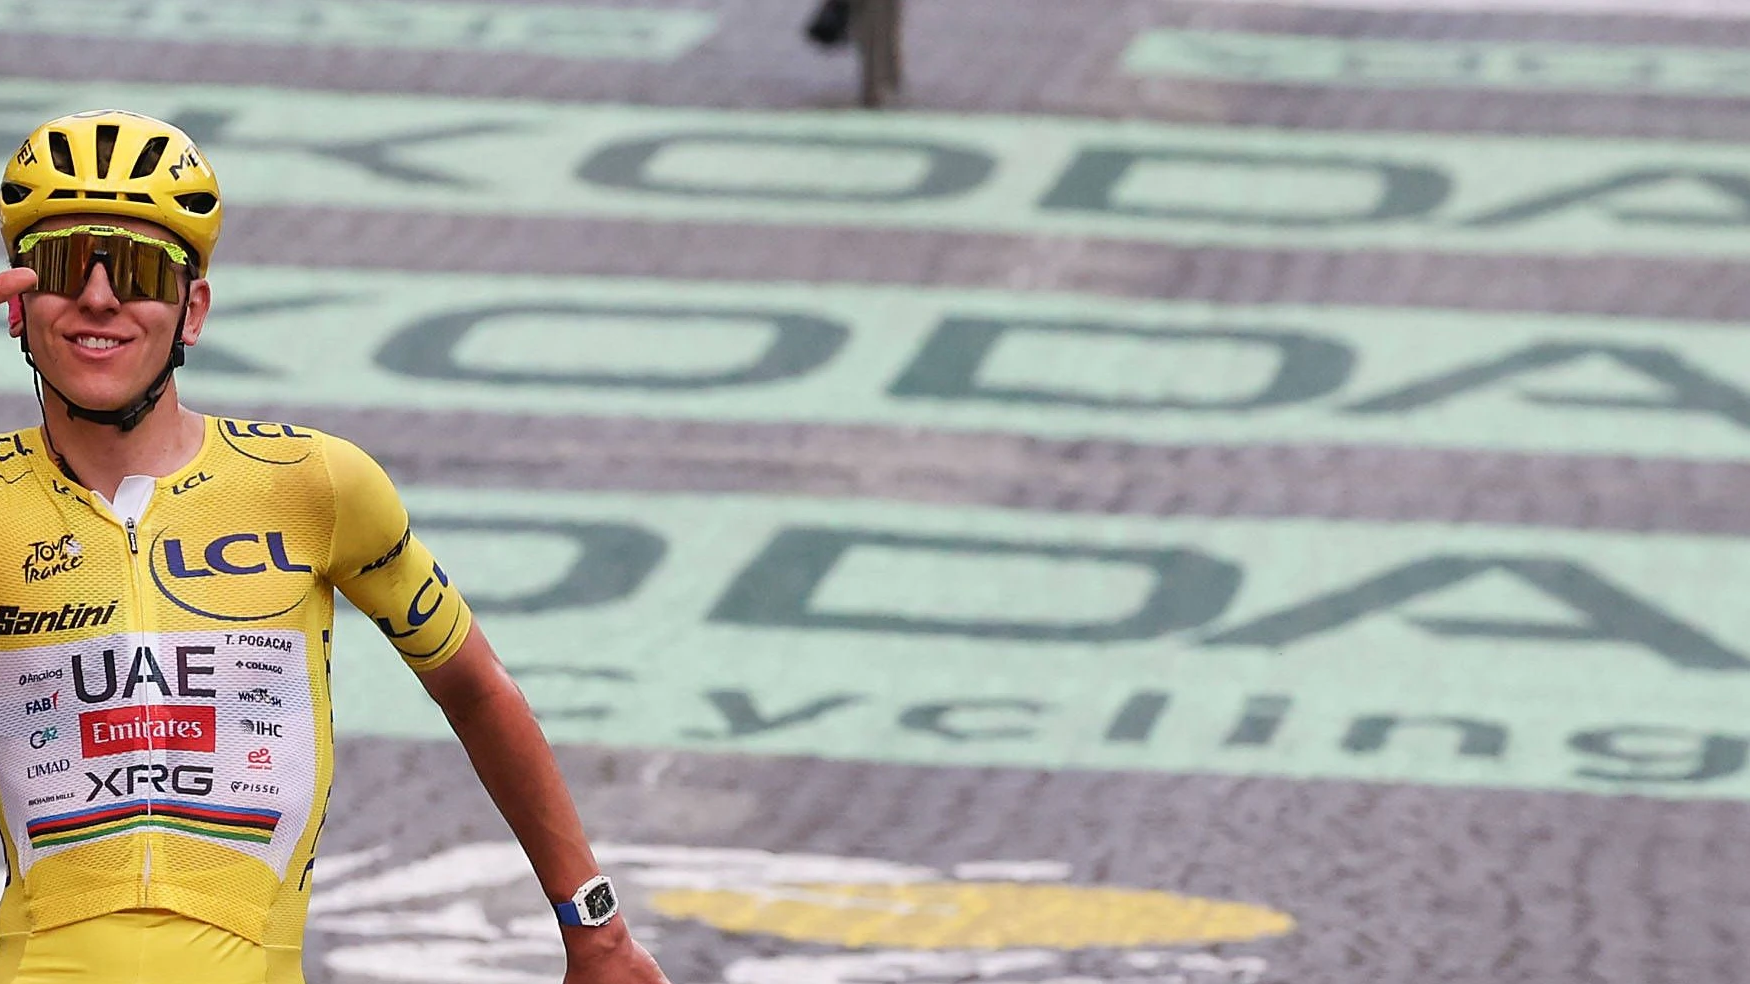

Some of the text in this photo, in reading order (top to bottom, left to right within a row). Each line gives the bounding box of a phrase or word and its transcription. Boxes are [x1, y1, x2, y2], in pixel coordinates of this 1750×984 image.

[16, 138, 38, 167] ET
[224, 420, 312, 439] LCL
[173, 471, 214, 495] LCL
[163, 532, 312, 578] LCL
[224, 634, 293, 653] T. POGACAR
[71, 646, 217, 704] UAE
[245, 661, 283, 675] COLNAGO
[92, 716, 203, 745] Emirates
[256, 720, 283, 738] IHC
[84, 764, 215, 803] XRG
[243, 784, 280, 795] PISSEI
